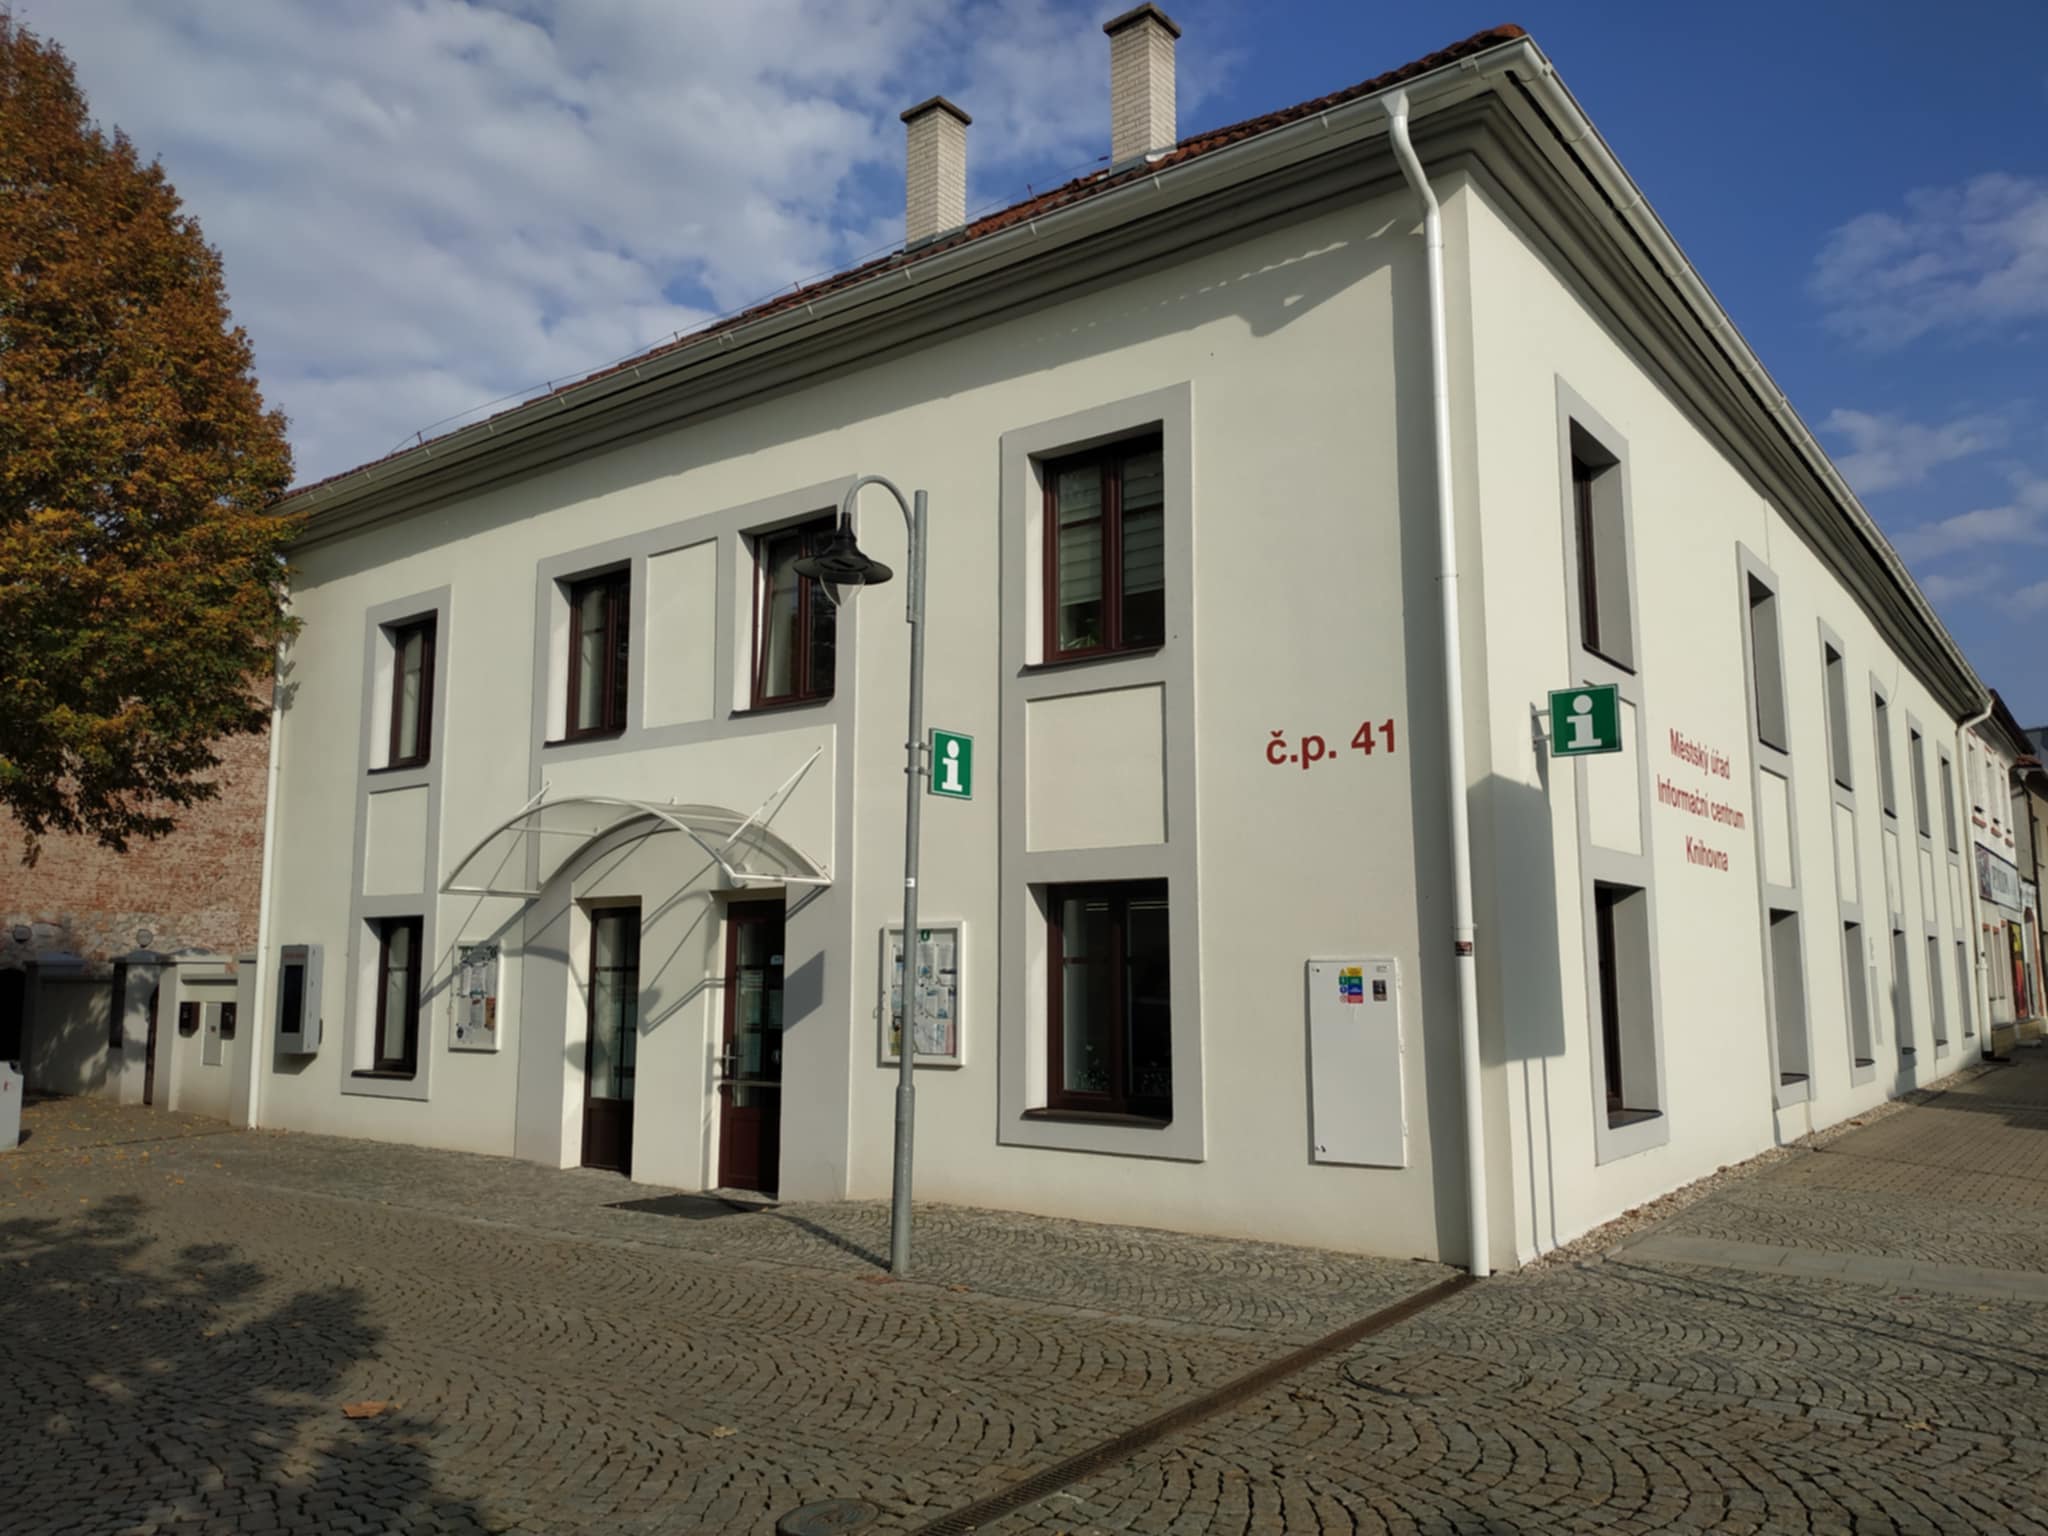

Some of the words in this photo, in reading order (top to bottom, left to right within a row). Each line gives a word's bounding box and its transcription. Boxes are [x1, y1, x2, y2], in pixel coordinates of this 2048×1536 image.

[1265, 729, 1337, 770] č.p.
[1350, 718, 1396, 756] 41
[1566, 694, 1602, 749] i
[941, 738, 963, 792] i
[1669, 727, 1709, 777] Městský
[1711, 748, 1731, 780] úřad
[1657, 774, 1709, 819] Informační
[1710, 800, 1745, 830] centrum
[1685, 835, 1729, 872] Knihovna
